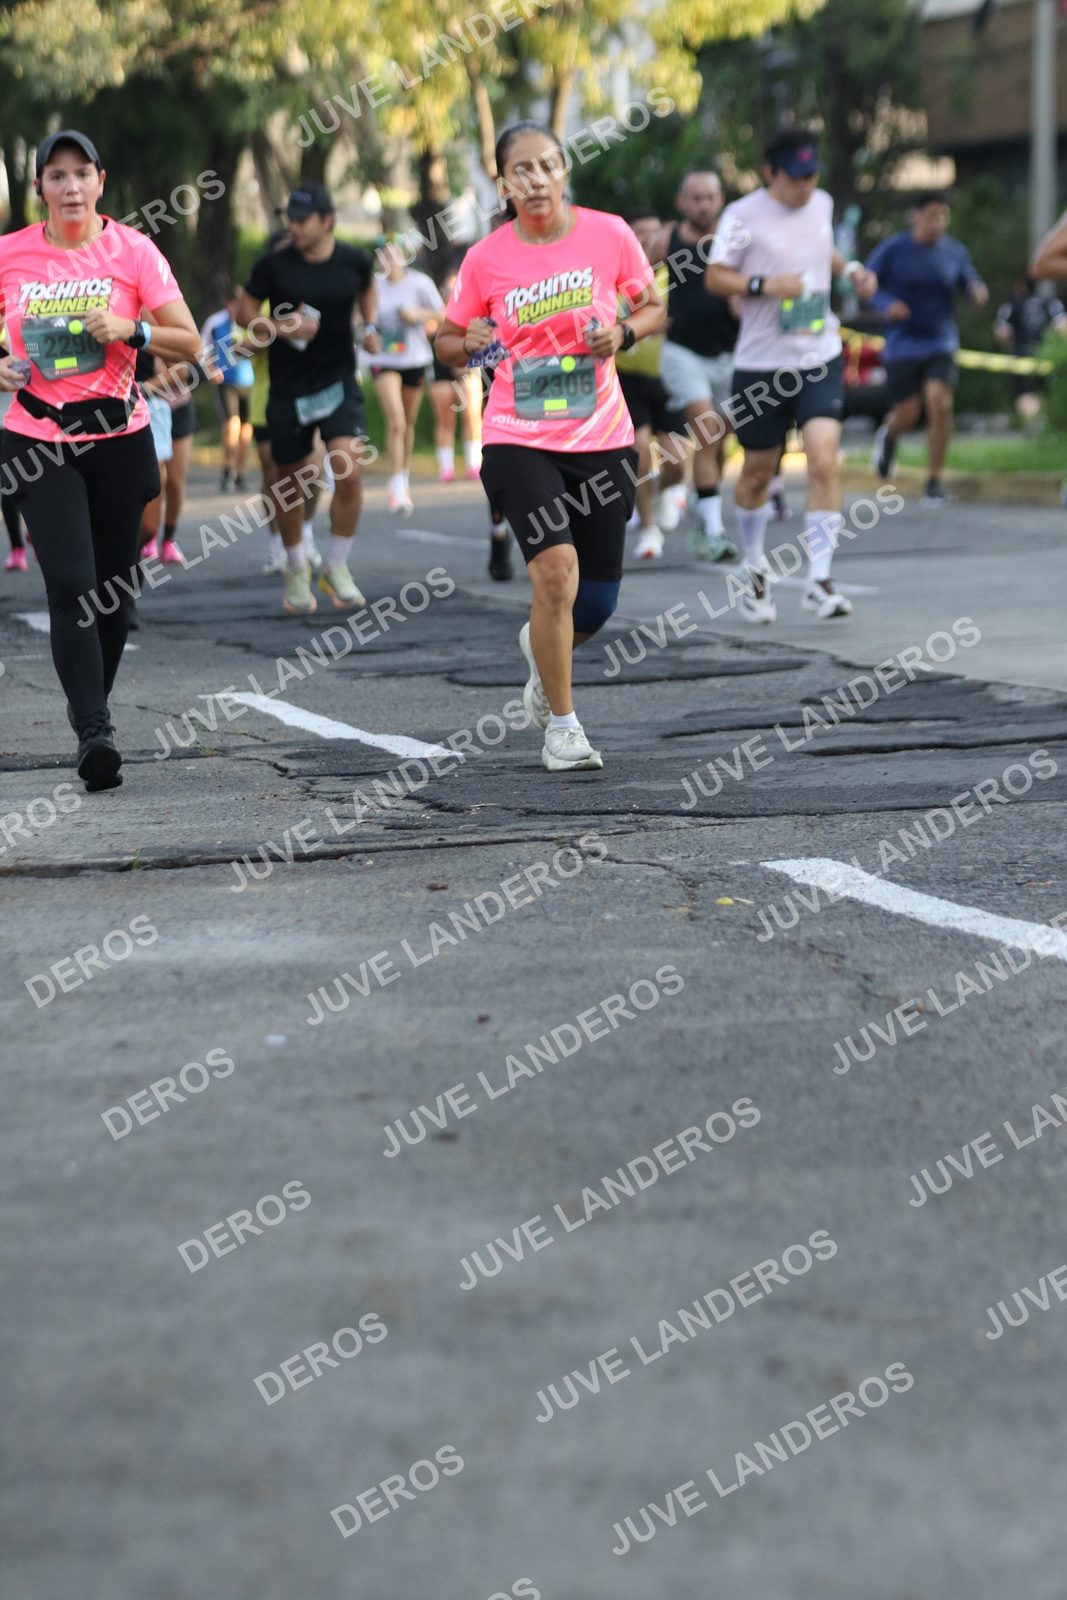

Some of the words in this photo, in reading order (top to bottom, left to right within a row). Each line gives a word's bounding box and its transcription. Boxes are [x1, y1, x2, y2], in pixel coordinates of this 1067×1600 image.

[18, 277, 113, 305] TOCHITOS
[25, 295, 109, 315] RUNNERS
[504, 266, 593, 319] TOCHITOS
[518, 287, 592, 325] RUNNERS
